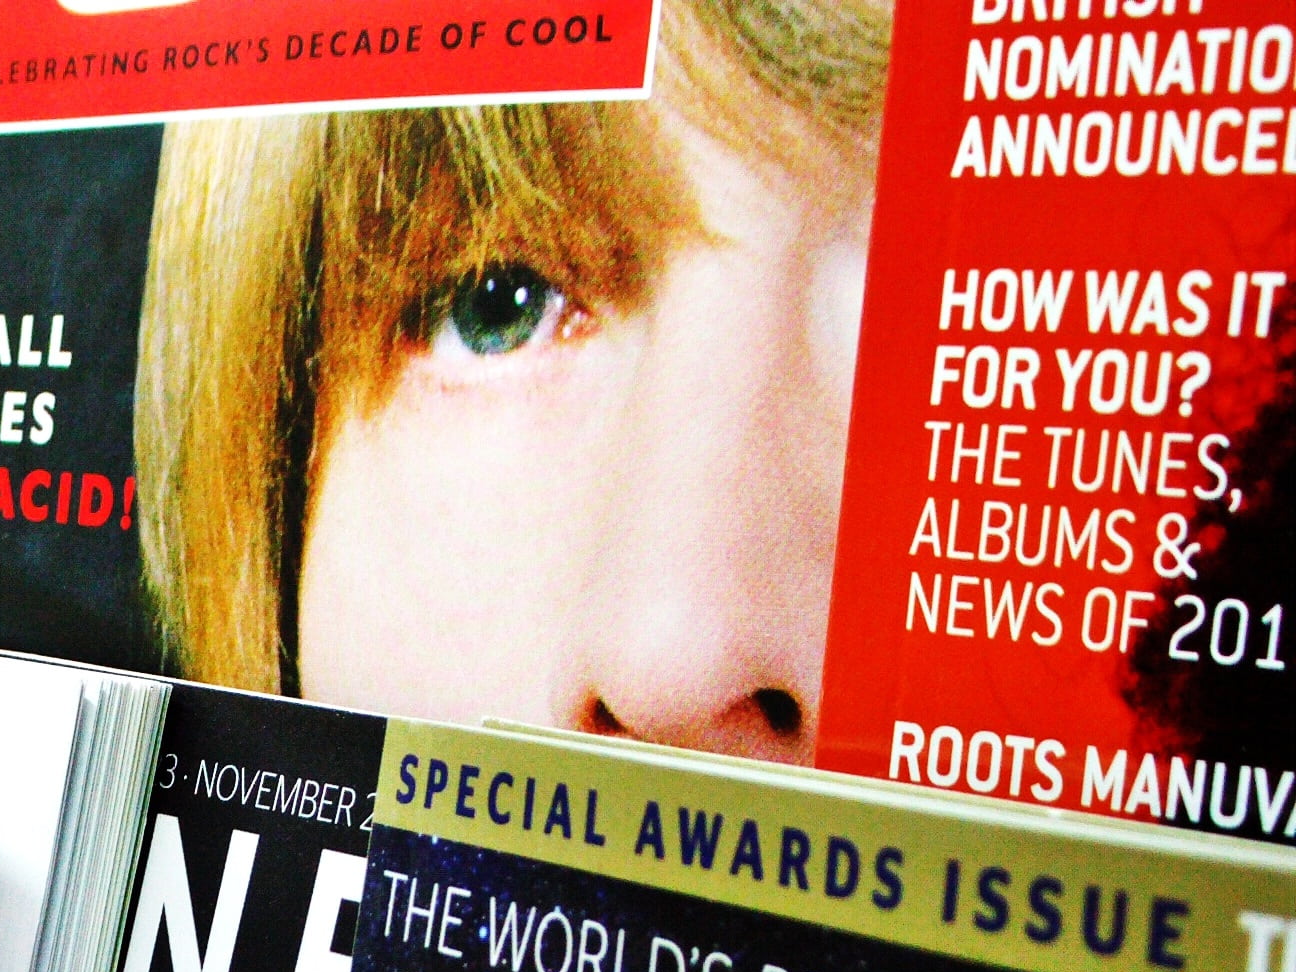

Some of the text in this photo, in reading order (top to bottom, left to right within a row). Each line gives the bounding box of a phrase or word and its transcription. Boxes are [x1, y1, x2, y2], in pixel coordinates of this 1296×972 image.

[163, 37, 271, 72] ROCK'S
[285, 25, 423, 61] DECADE
[440, 21, 487, 50] OF
[506, 14, 613, 47] COOL
[964, 24, 1296, 101] NOMINATIO
[951, 107, 1296, 178] ANNOUNCE
[939, 268, 1287, 338] HOW WAS IT
[930, 345, 1212, 419] FOR YOU?
[925, 421, 1243, 513] THE TUNES,
[909, 497, 1202, 580] ALBUMS &
[905, 571, 1065, 648] NEWS
[1080, 586, 1155, 653] OF
[193, 758, 358, 828] NOVEMBER
[889, 720, 1296, 832] ROOTS MANUV
[395, 752, 607, 847] SPECIAL
[635, 799, 906, 911] AWARDS
[940, 857, 1192, 972] ISSUE
[382, 870, 465, 960] THE
